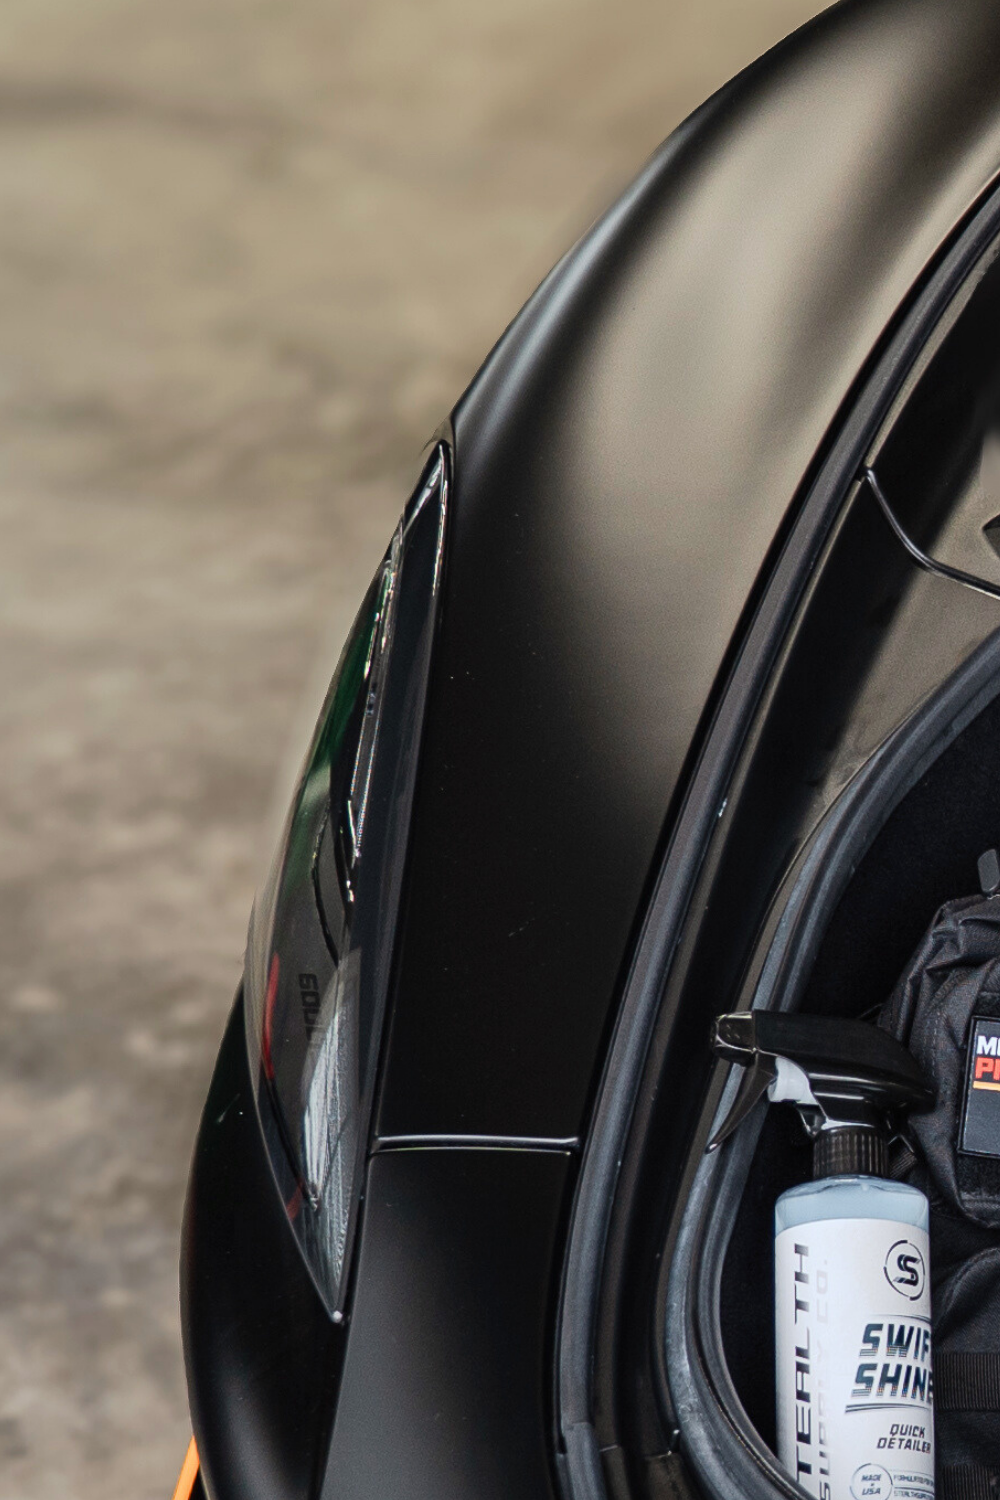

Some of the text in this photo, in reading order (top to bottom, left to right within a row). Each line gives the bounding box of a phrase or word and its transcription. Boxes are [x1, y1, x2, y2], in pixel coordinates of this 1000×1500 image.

[859, 1323, 931, 1362] SWIF
[794, 1242, 812, 1484] TEALTH
[851, 1363, 934, 1405] SHINE
[876, 1436, 931, 1454] DETAILER
[889, 1423, 926, 1439] QUICK
[861, 1487, 881, 1496] USA
